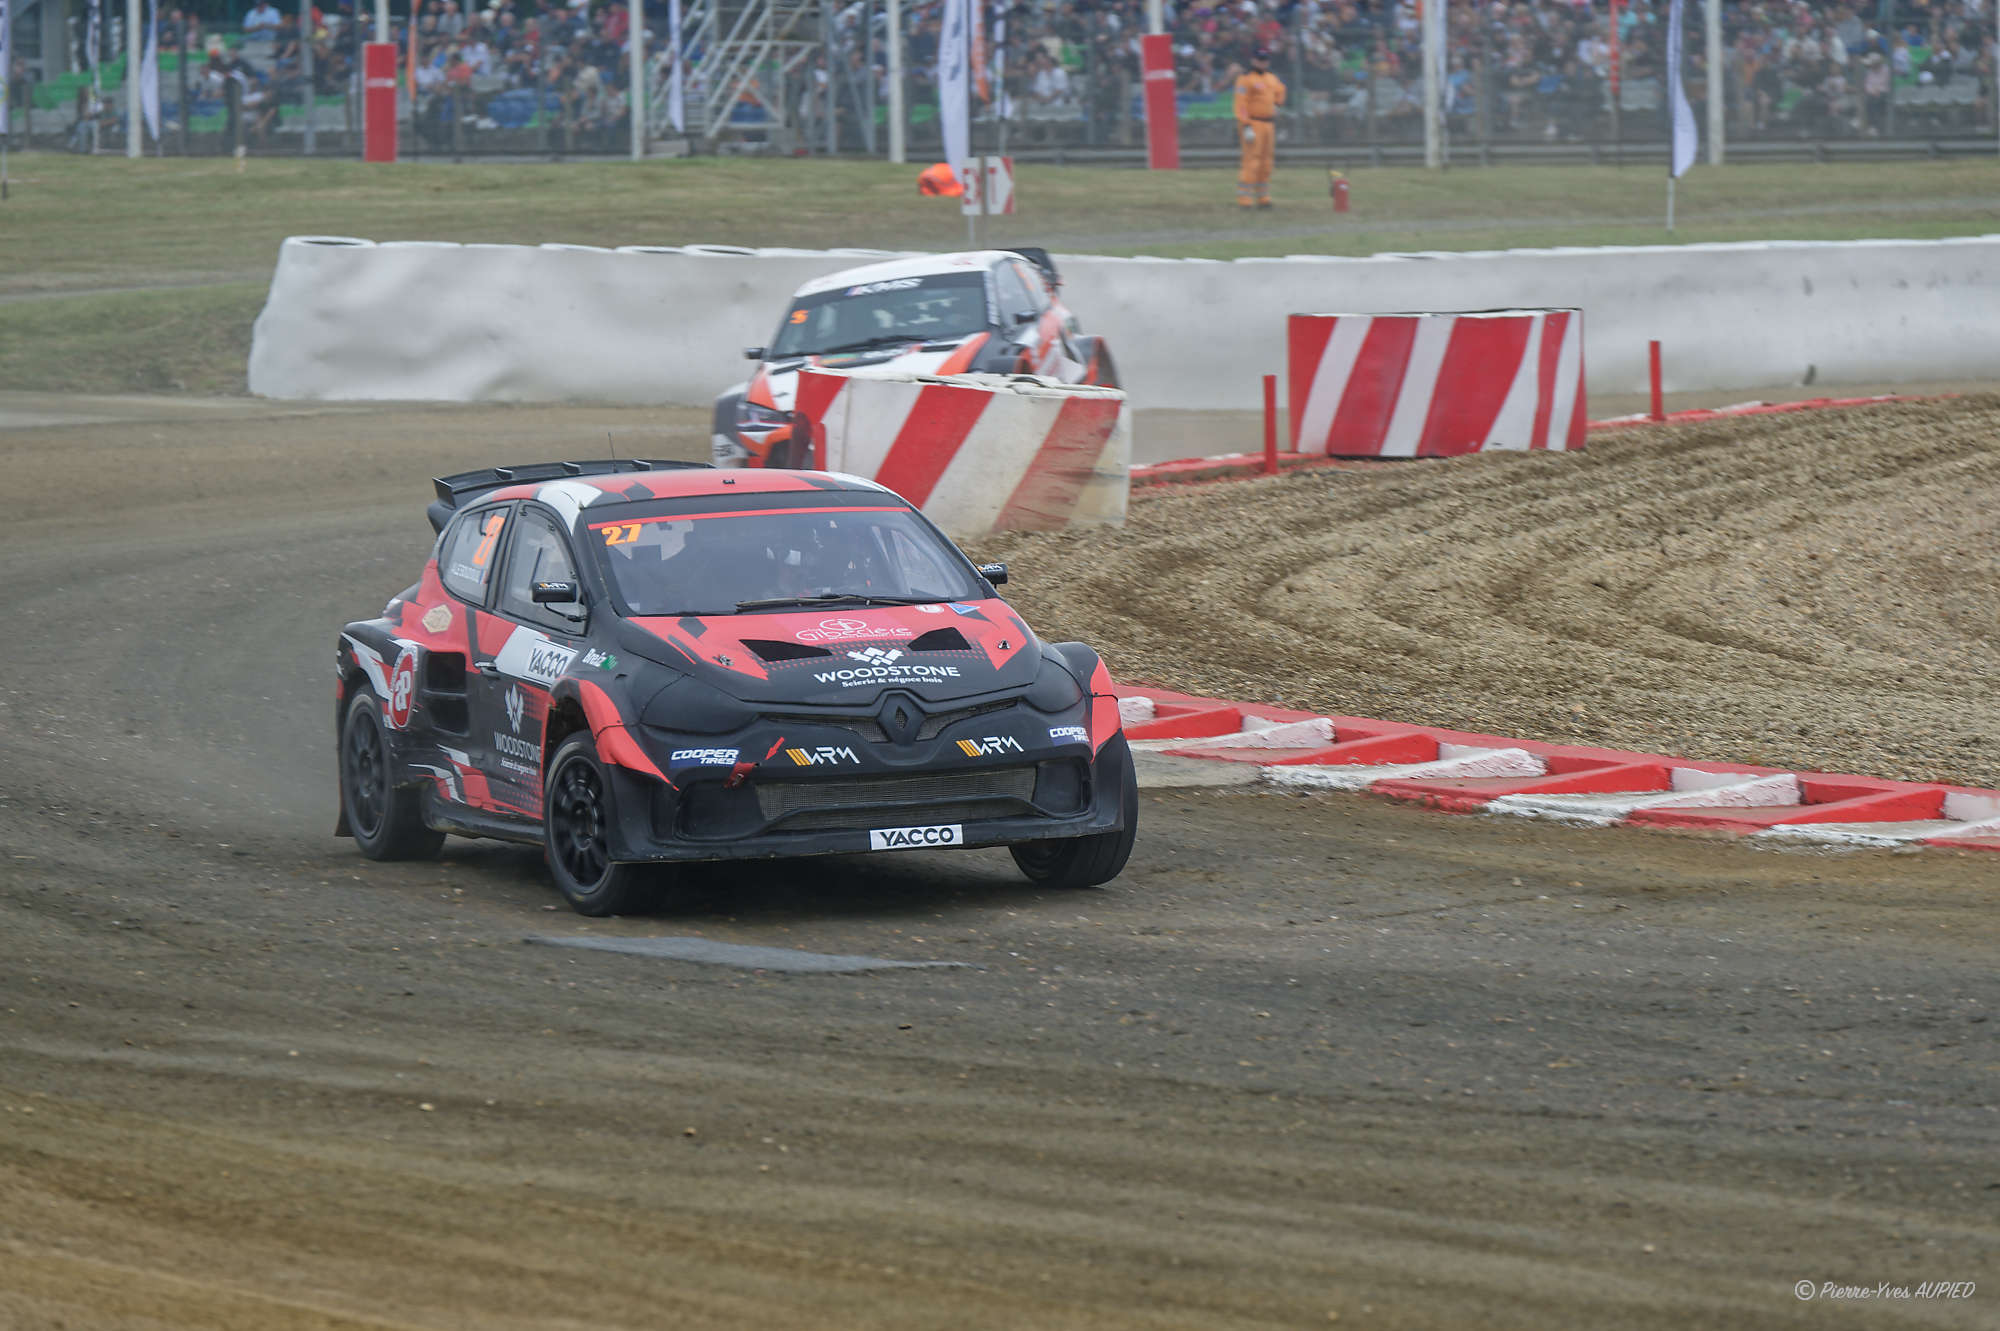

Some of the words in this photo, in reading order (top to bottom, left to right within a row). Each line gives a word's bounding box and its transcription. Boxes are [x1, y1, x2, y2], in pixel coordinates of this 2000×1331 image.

[601, 523, 642, 546] 27
[528, 648, 569, 677] YACCO
[813, 665, 961, 683] WOODSTONE
[841, 678, 876, 687] Scierie
[887, 676, 921, 684] négoce
[922, 676, 943, 684] bois
[494, 731, 541, 762] WOODSTONE
[671, 749, 740, 760] COOPER
[700, 757, 736, 765] TIRES
[880, 827, 954, 847] YACCO
